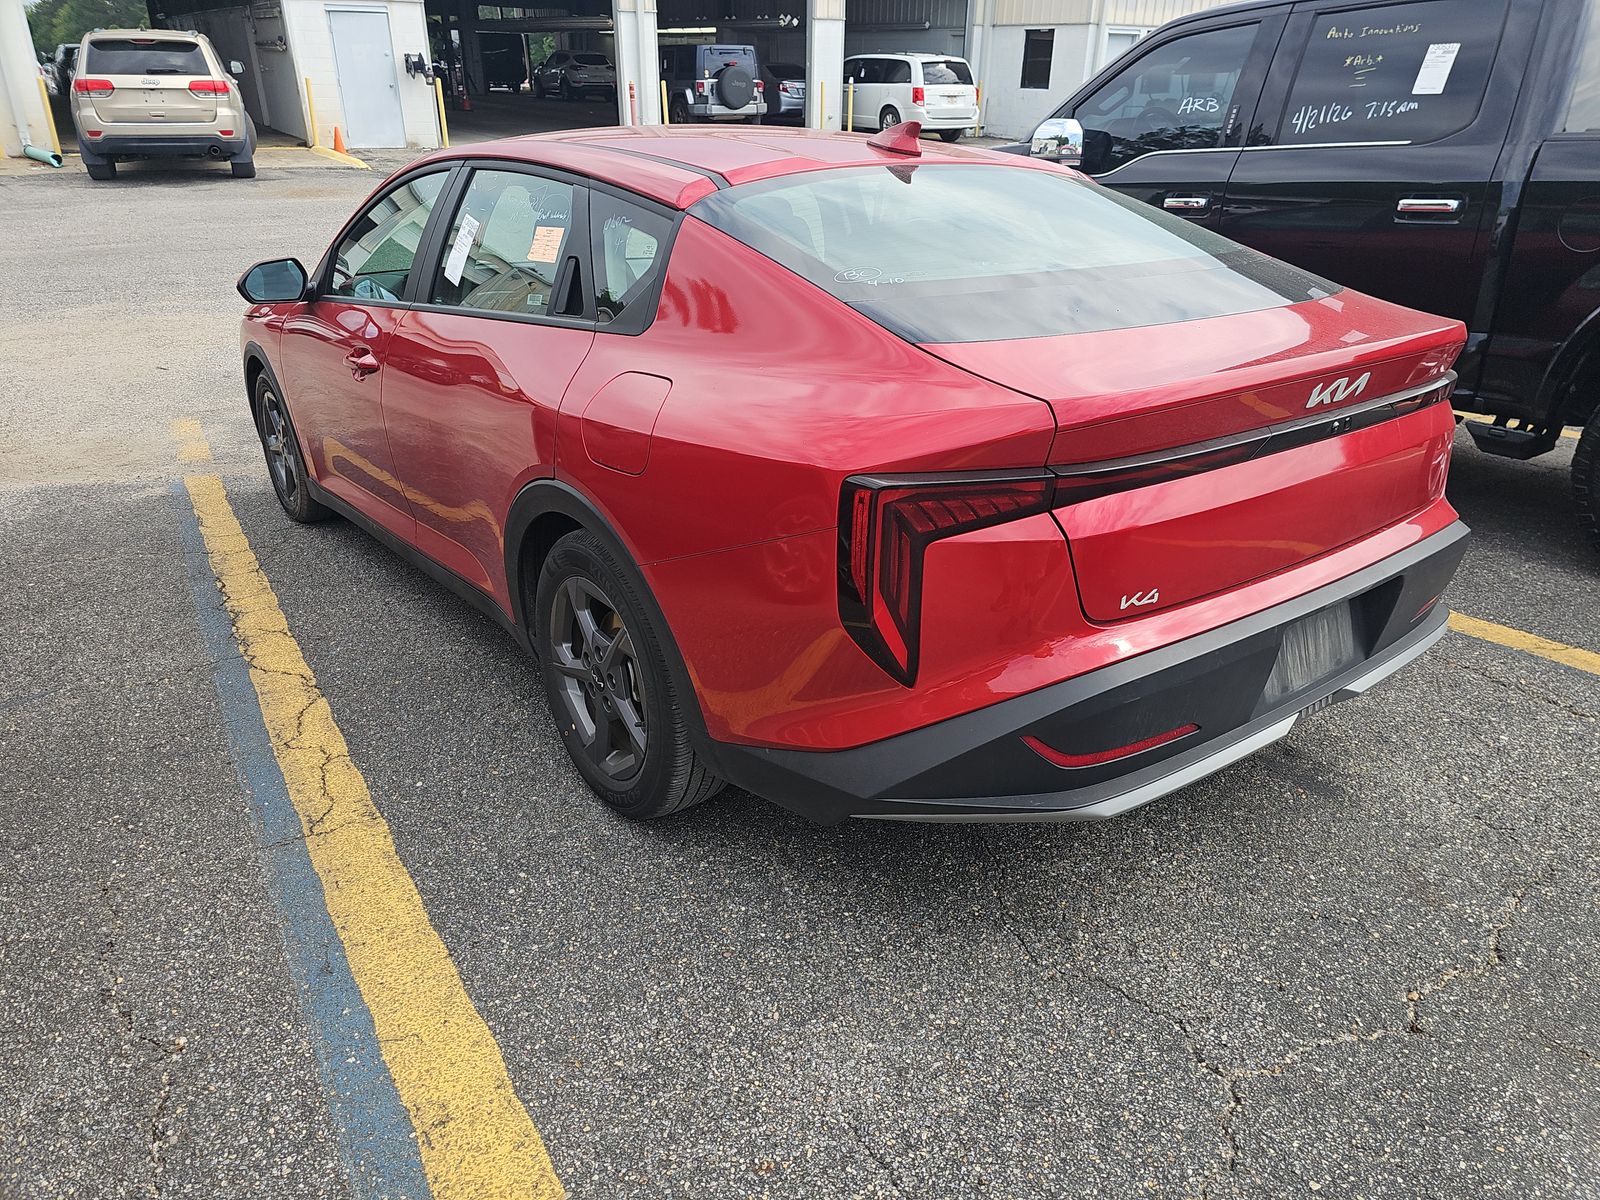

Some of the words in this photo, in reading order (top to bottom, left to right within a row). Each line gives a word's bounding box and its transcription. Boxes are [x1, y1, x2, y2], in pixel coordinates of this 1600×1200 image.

[141, 78, 160, 86] Jeep
[1177, 96, 1220, 115] ARB
[1292, 102, 1352, 134] 4/21/26
[867, 277, 905, 287] 4-10
[1306, 371, 1371, 409] KIA
[1120, 588, 1159, 610] K4
